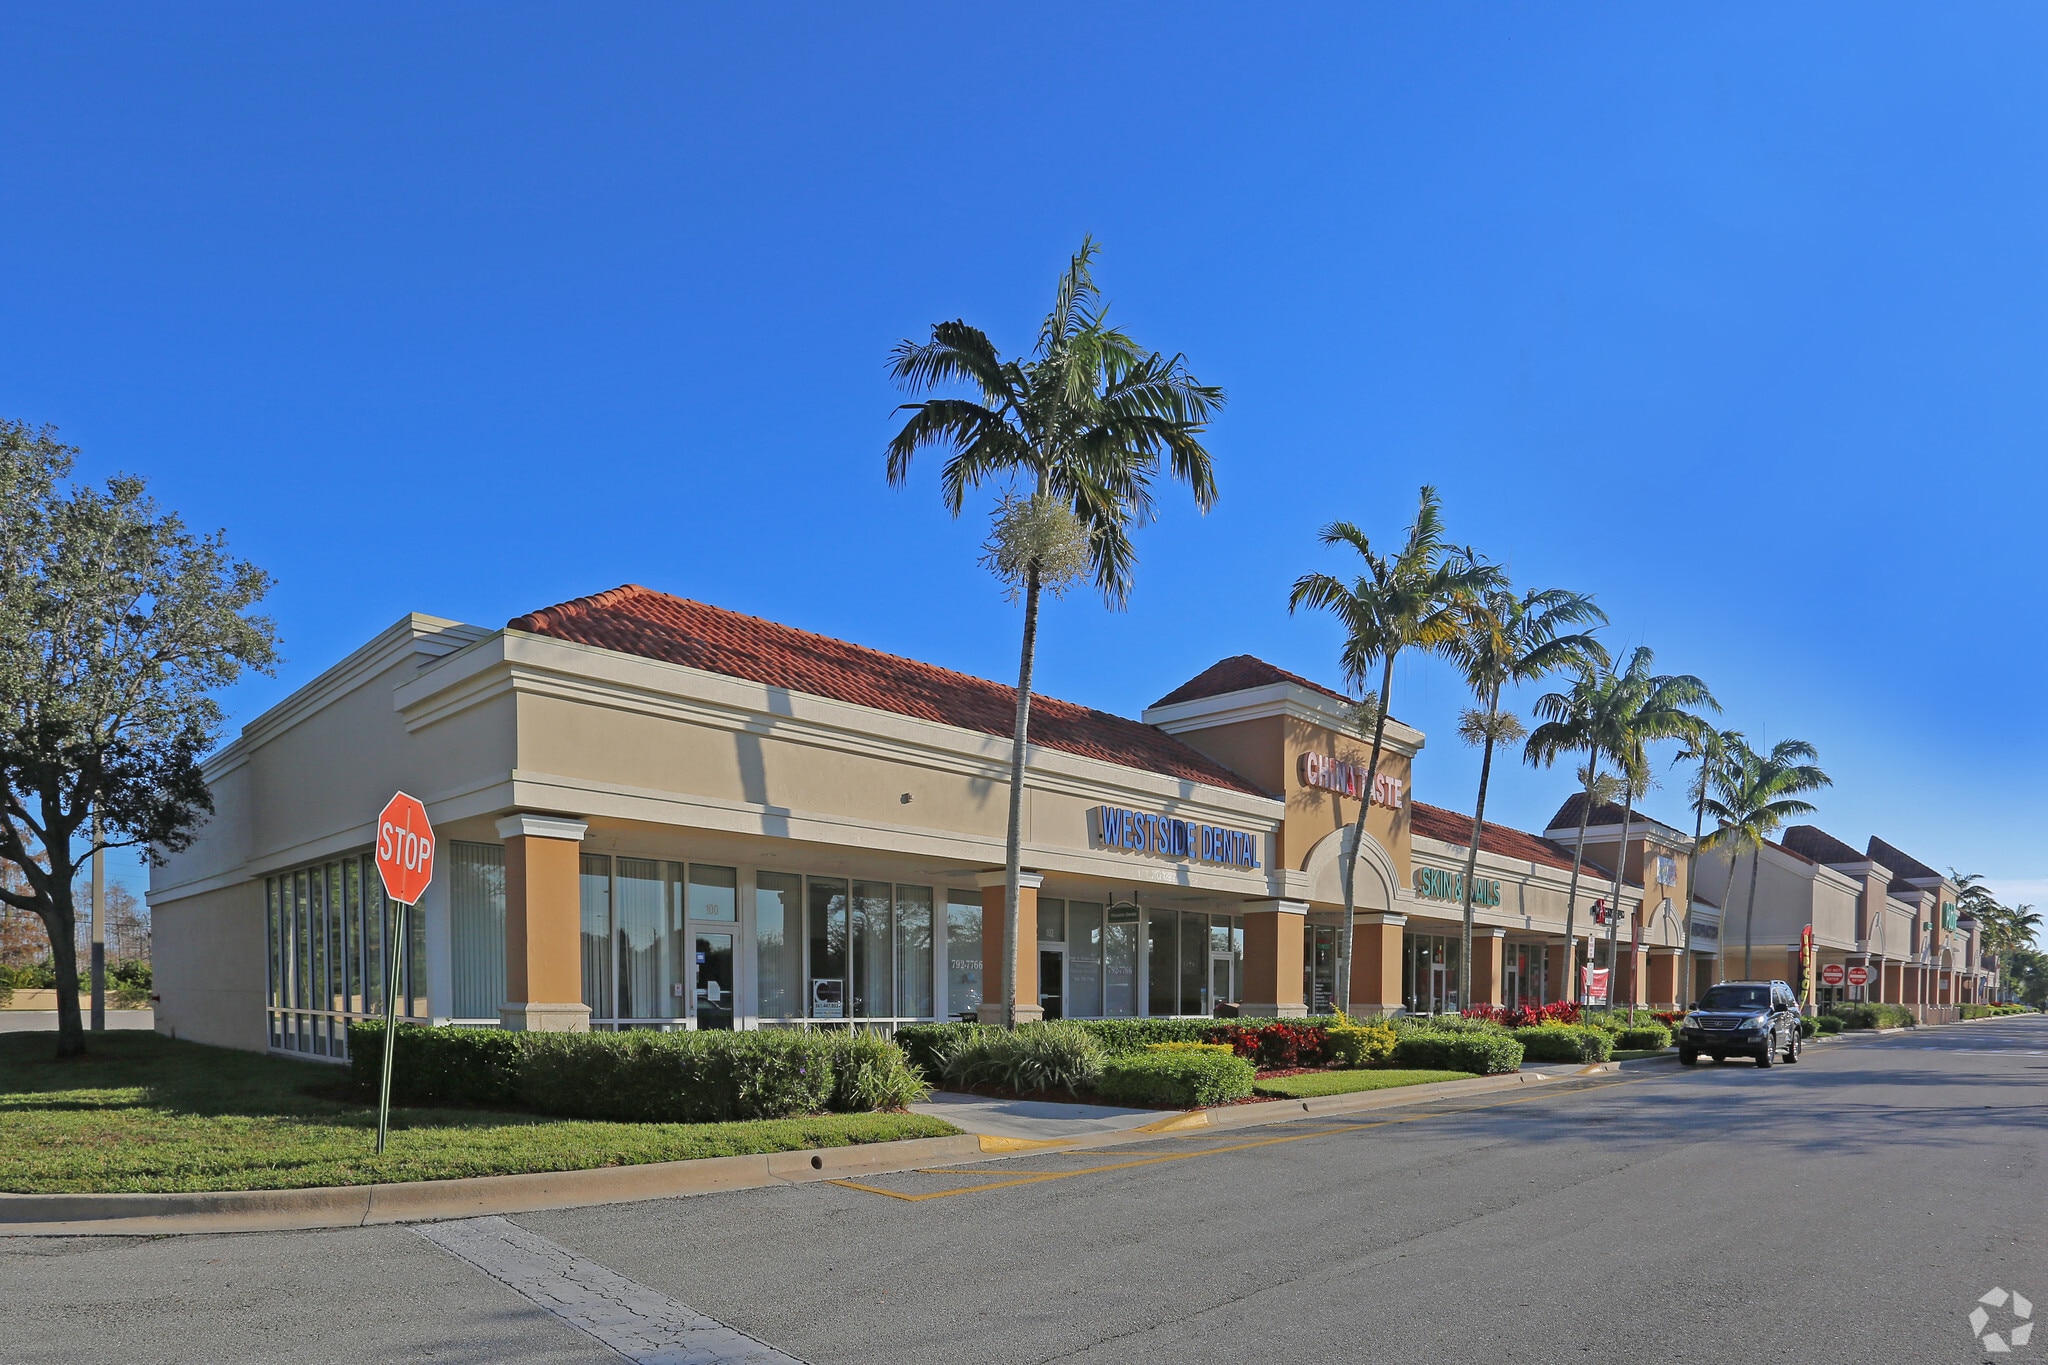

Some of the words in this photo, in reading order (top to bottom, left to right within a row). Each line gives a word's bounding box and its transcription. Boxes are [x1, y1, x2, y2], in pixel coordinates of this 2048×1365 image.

[1307, 751, 1357, 797] CHINA
[380, 821, 431, 874] STOP
[1101, 805, 1197, 859] WESTSIDE
[1202, 824, 1261, 869] DENTAL
[1422, 866, 1453, 900] SKIN
[1454, 873, 1463, 901] &
[705, 904, 719, 916] 100
